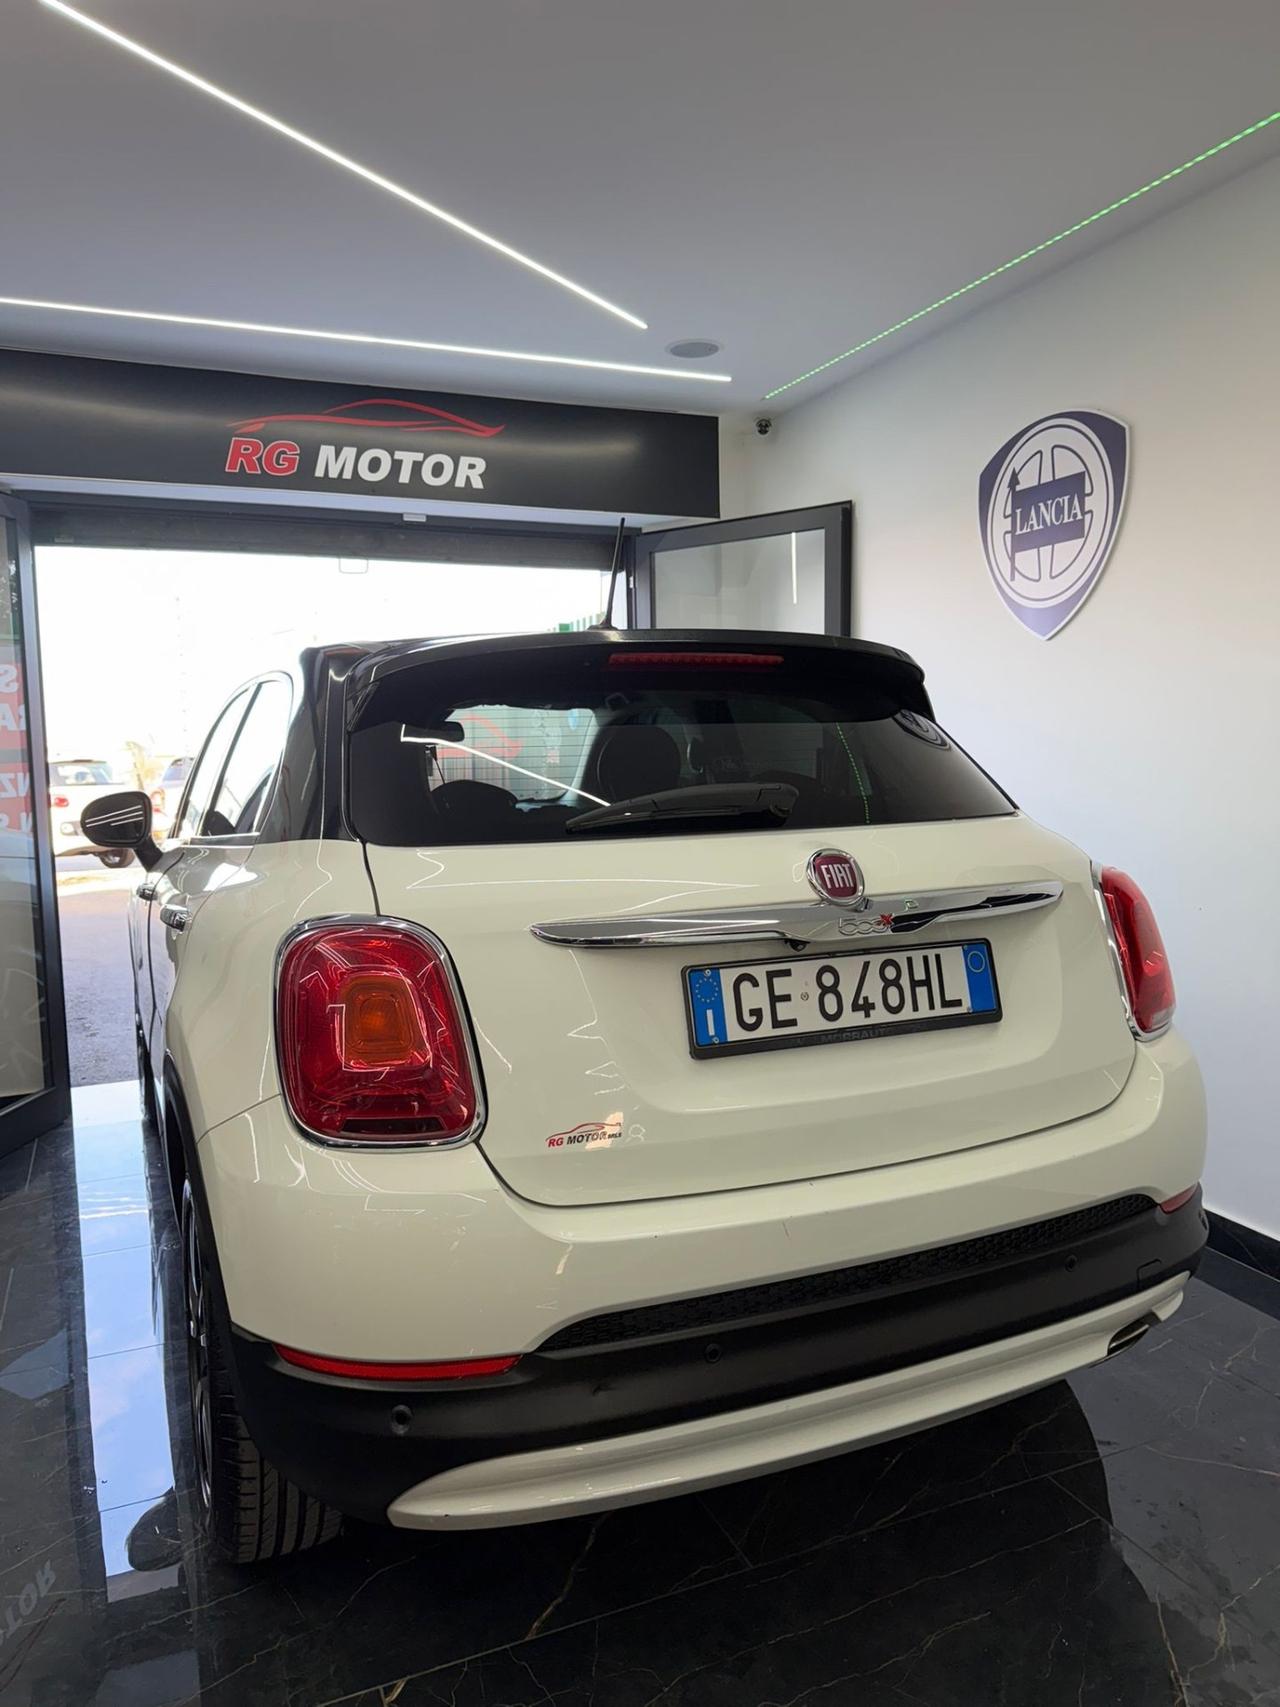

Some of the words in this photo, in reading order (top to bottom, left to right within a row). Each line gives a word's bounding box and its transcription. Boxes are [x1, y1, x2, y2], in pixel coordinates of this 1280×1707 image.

[225, 437, 300, 476] RG
[314, 444, 487, 489] MOTOR
[1015, 493, 1083, 535] LANCIA
[820, 863, 852, 889] FIAT
[733, 968, 798, 1032] GE
[816, 953, 963, 1022] 848HL
[548, 1137, 564, 1148] RG
[566, 1131, 608, 1145] MOTOR
